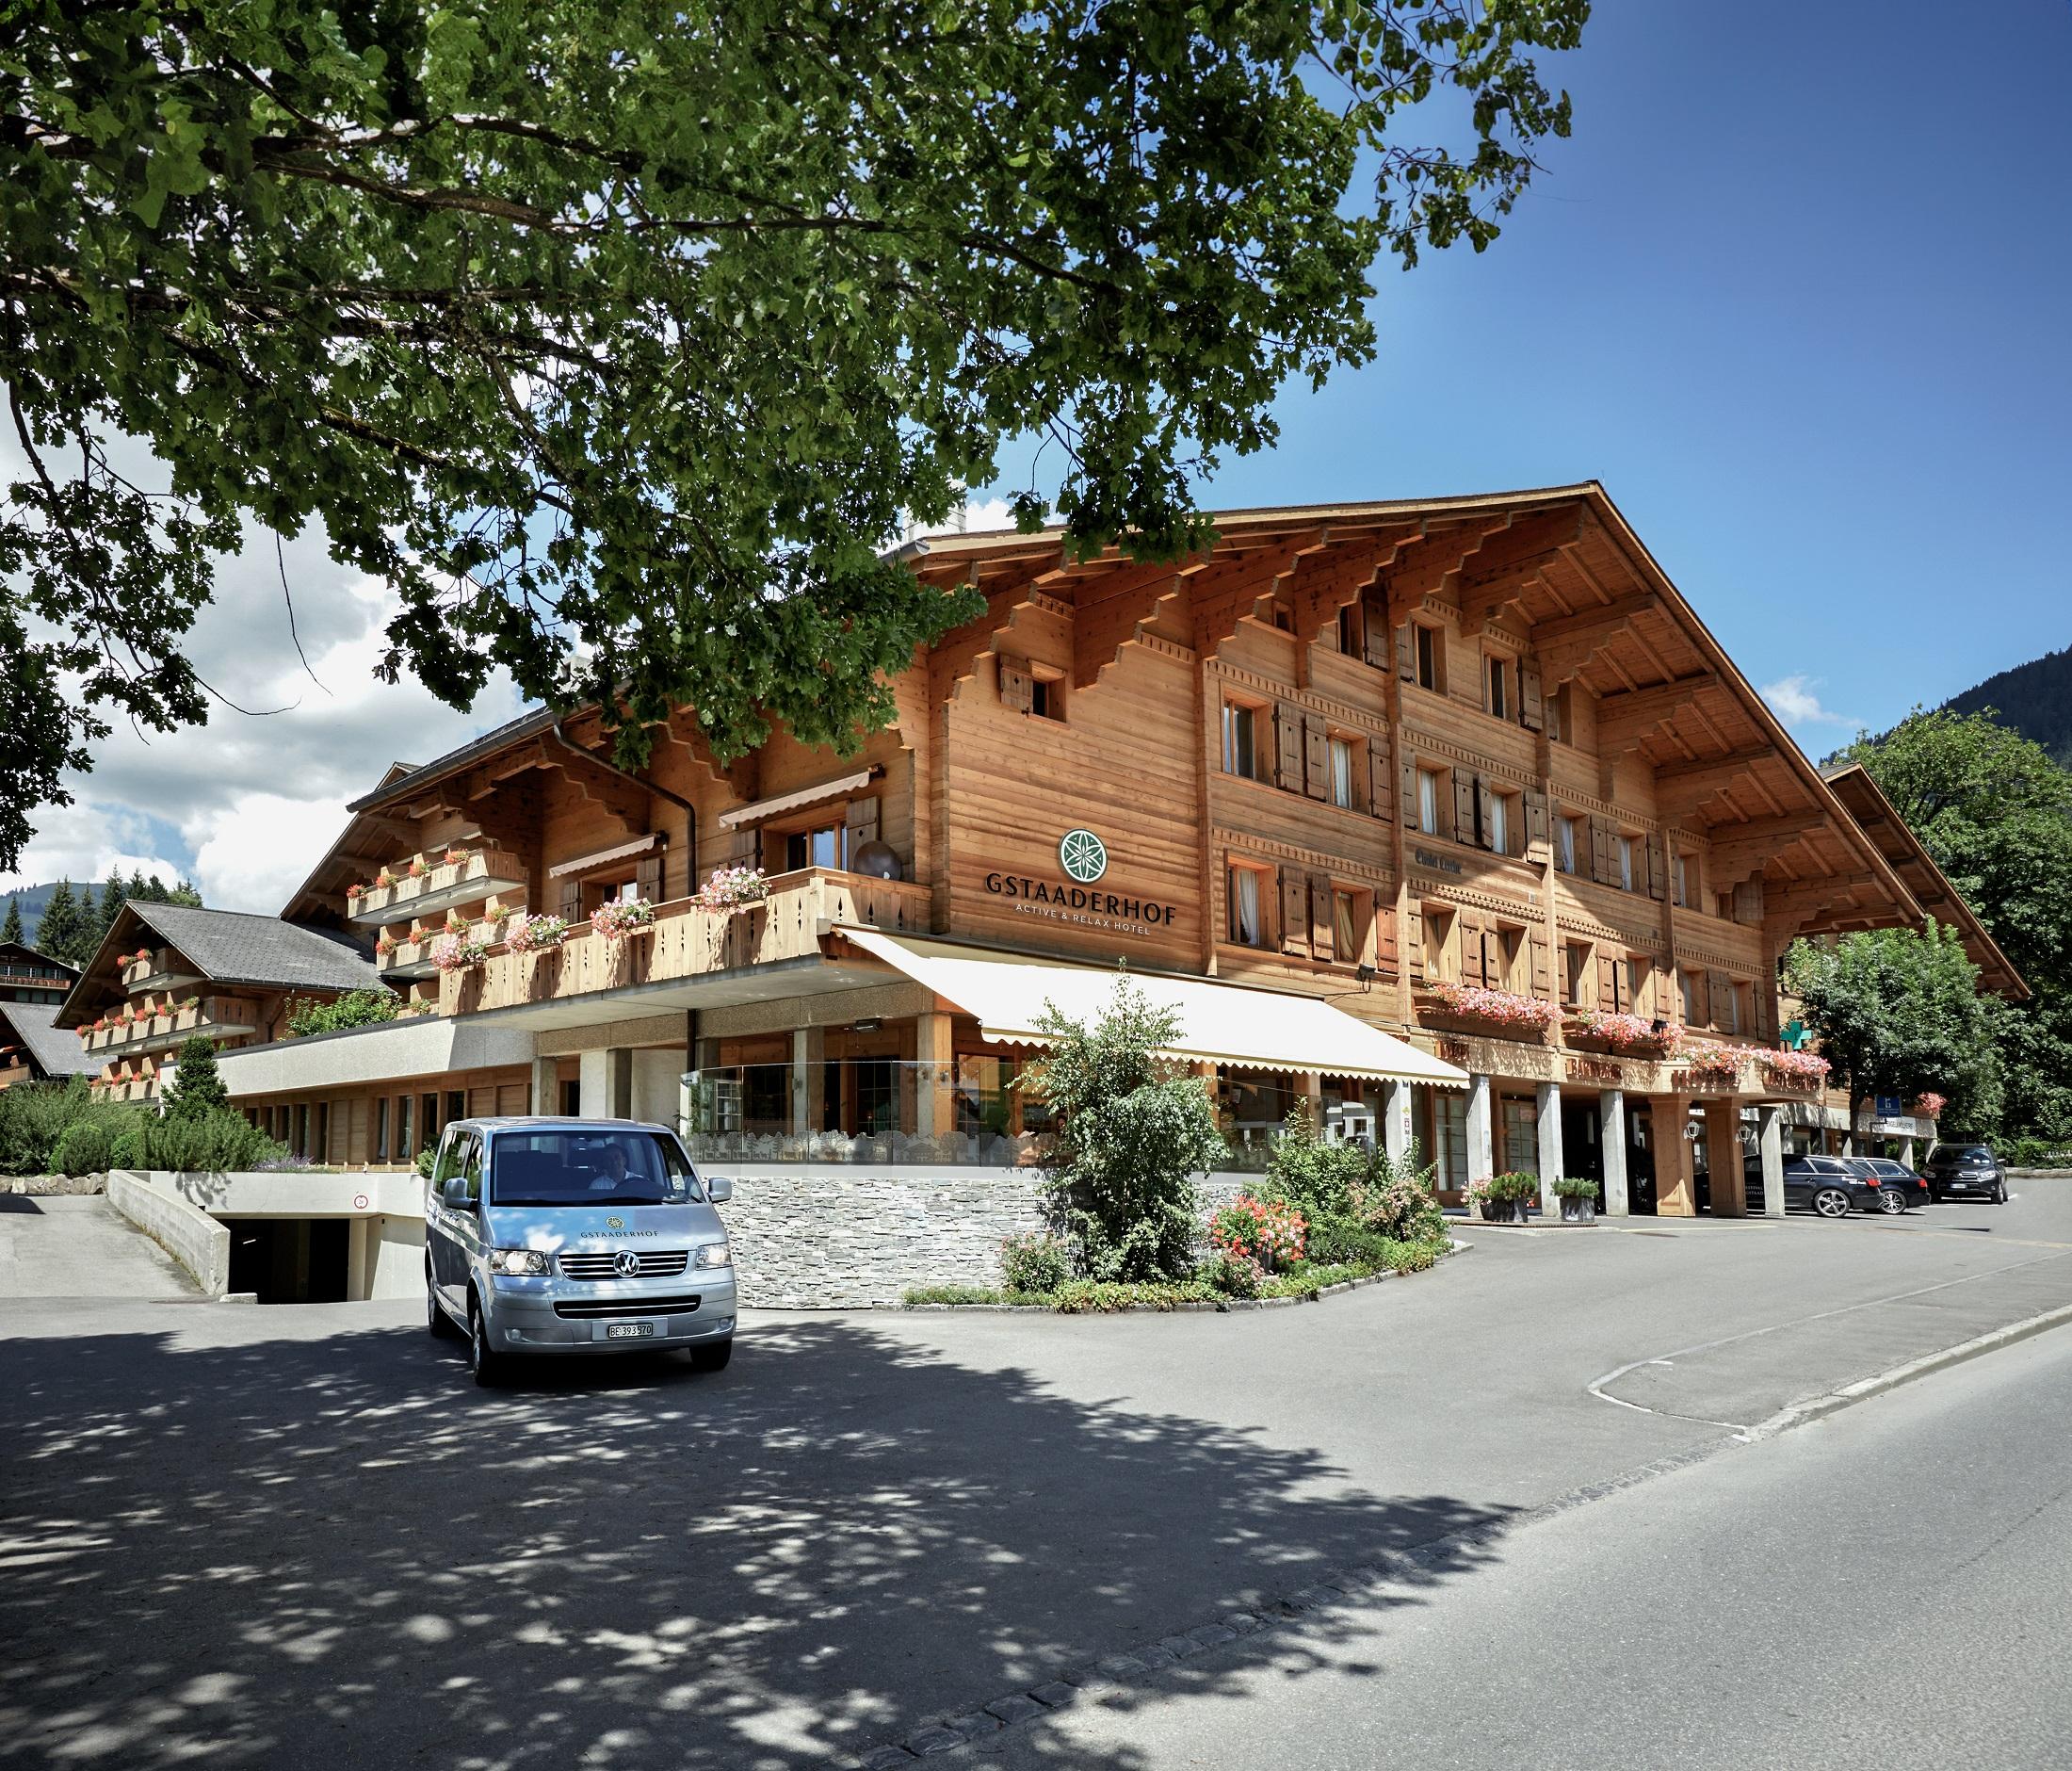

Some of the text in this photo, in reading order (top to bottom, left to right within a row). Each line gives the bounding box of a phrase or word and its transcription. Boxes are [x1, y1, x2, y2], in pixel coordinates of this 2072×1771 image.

[986, 872, 1176, 926] GSTAADERHOF
[1015, 903, 1151, 935] ACTIVE & RELAX HOTEL
[580, 1230, 659, 1239] GSTAADERHOF
